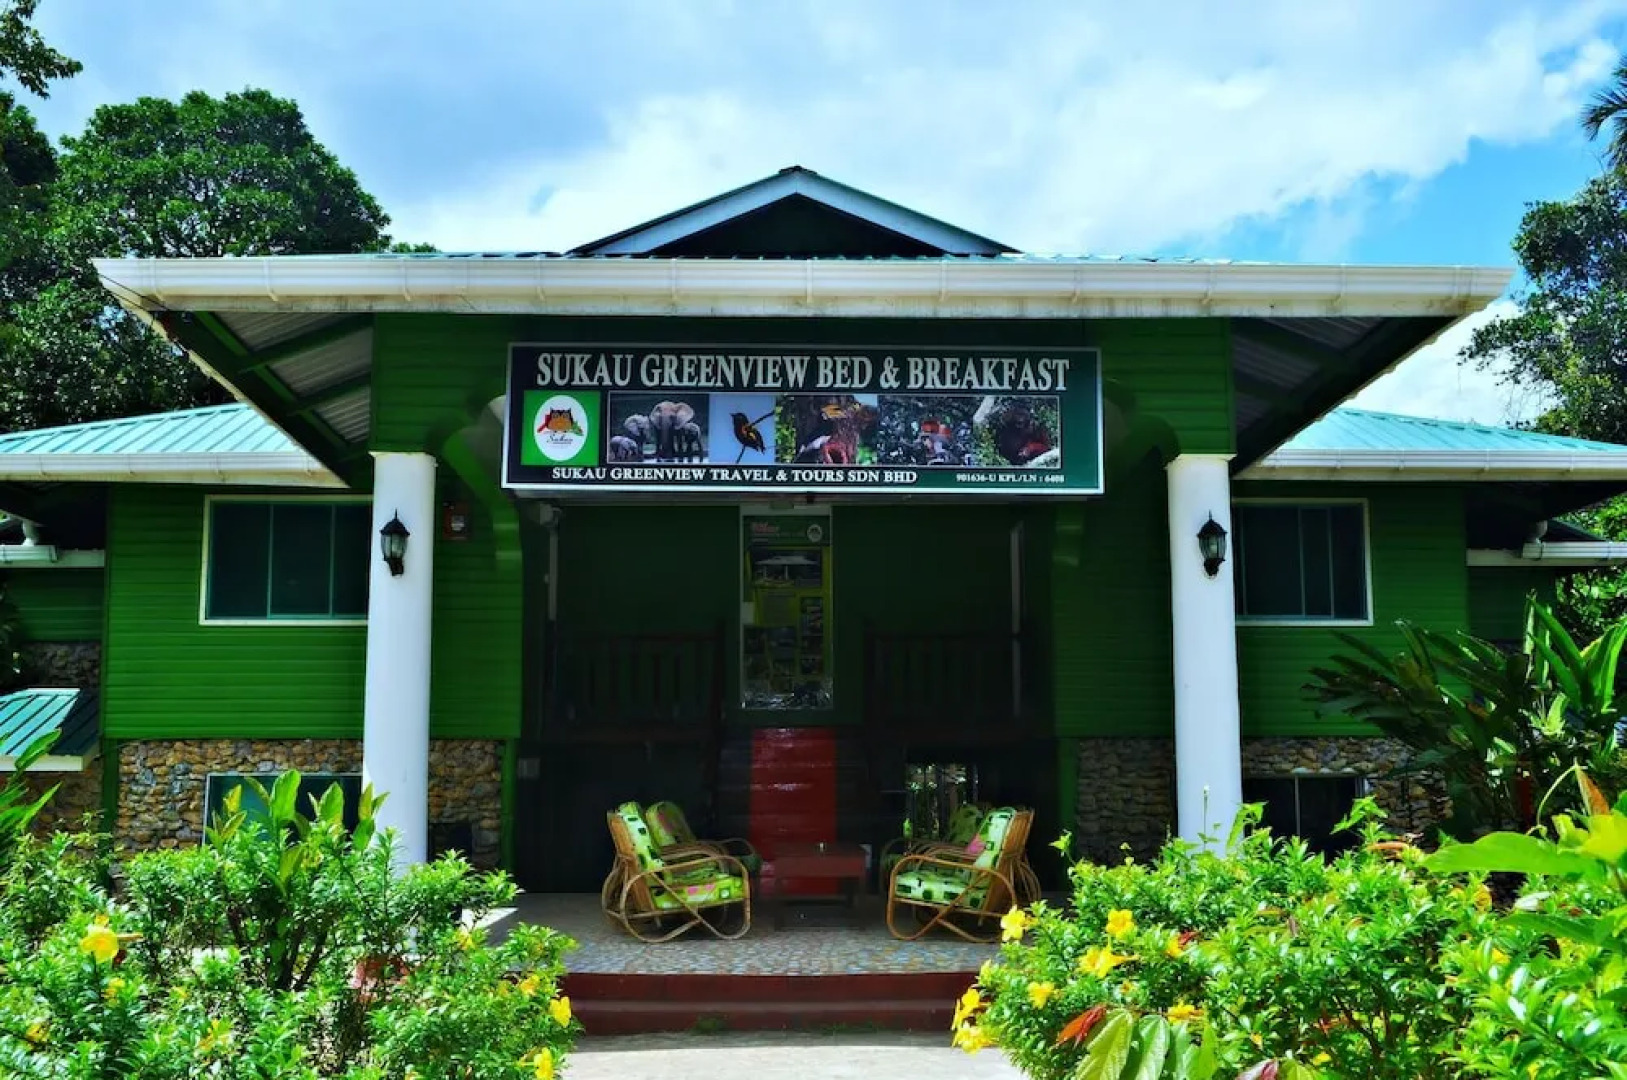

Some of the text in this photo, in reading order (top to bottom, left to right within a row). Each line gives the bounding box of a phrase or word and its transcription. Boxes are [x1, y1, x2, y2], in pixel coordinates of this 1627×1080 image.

[537, 352, 1070, 391] SUKAU GREENVIEW BED & BREAKFAST
[552, 467, 917, 483] SUKAU GREENVIEW TRAVEL & TOURS SDN BHD
